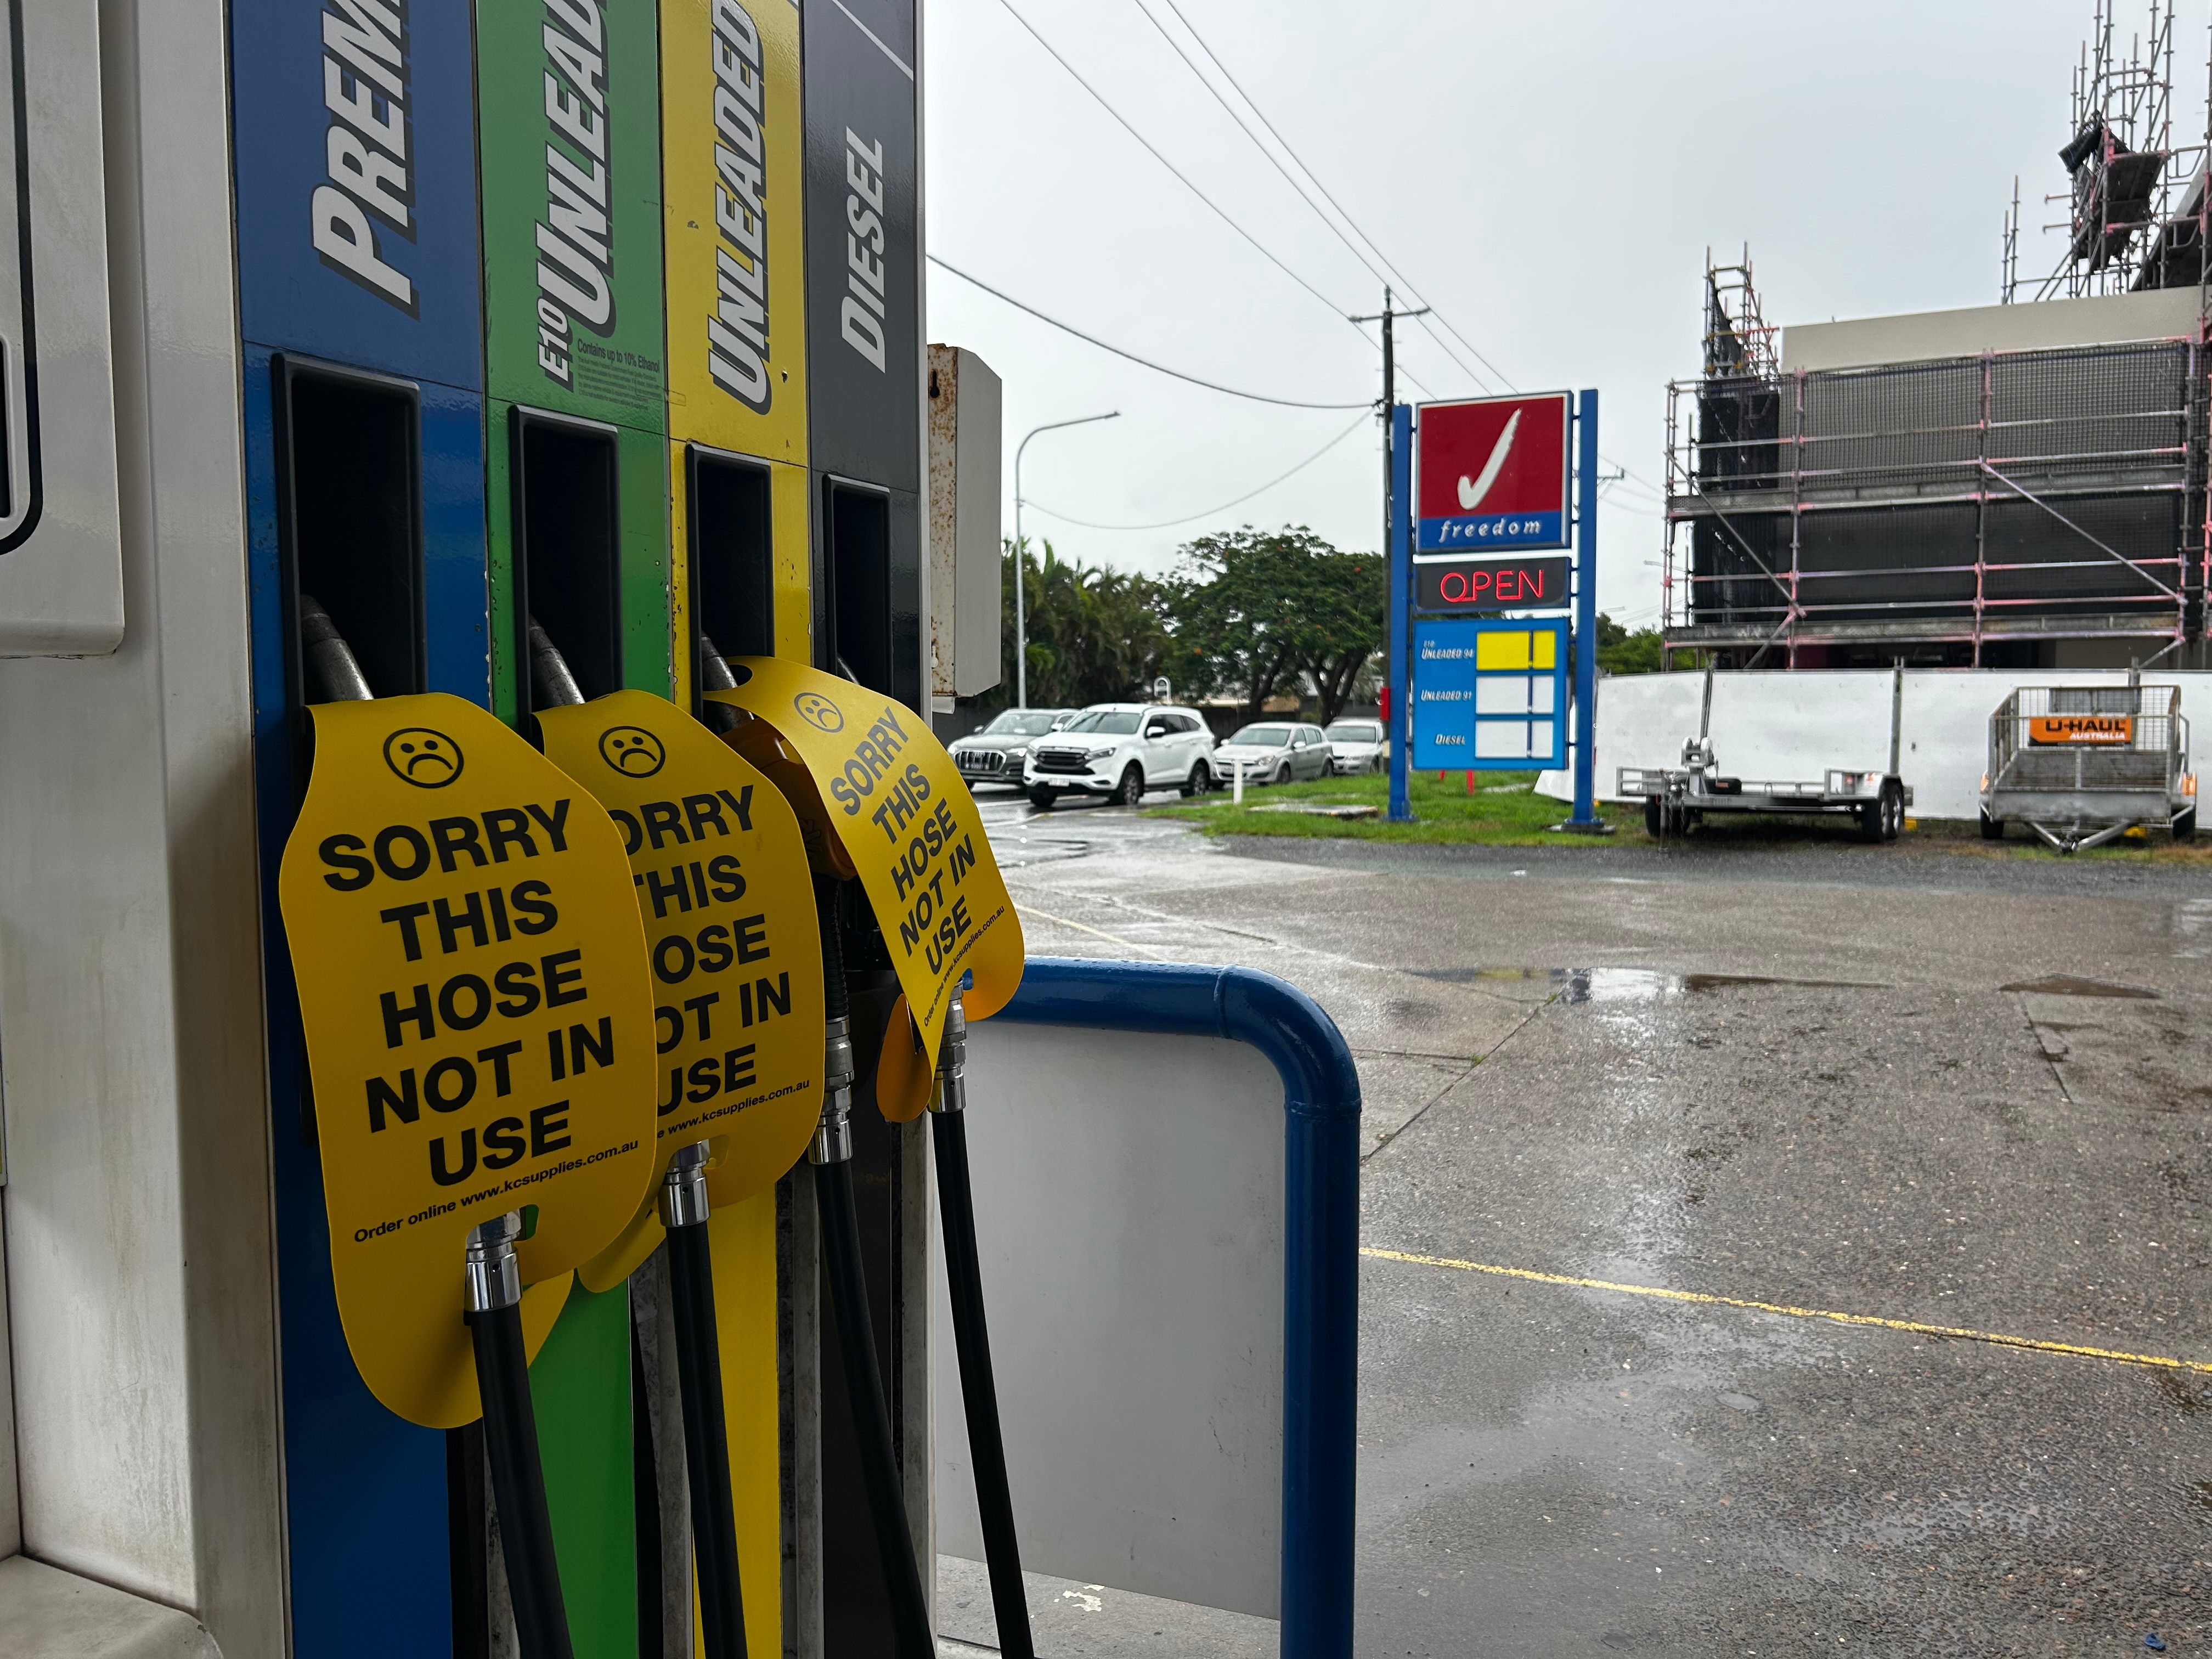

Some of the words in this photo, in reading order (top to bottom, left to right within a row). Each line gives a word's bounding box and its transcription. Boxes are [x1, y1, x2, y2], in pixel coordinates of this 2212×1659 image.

[312, 0, 411, 305] PREM
[709, 0, 768, 405] UNLEADED
[842, 127, 886, 374] DIESEL
[537, 298, 569, 382] E10
[578, 338, 606, 359] Contains
[607, 349, 616, 364] up
[616, 349, 623, 363] to
[624, 352, 637, 367] 10%
[638, 355, 660, 373] Ethanol
[1438, 517, 1542, 543] freedom
[1440, 569, 1543, 602] OPEN
[1463, 648, 1474, 659] 94
[1462, 690, 1472, 701] 91
[2045, 718, 2125, 732] U-HAUL
[2069, 732, 2125, 740] AUSTRALIA
[831, 706, 909, 816] SORRY
[319, 798, 571, 891] SORRY
[607, 785, 754, 856] ORRY
[872, 764, 930, 845] THIS
[633, 855, 747, 919] HIS
[890, 797, 957, 903] HOSE
[380, 880, 558, 962] THIS
[899, 867, 944, 958] NOT
[949, 833, 975, 887] IN
[925, 894, 972, 975] USE
[653, 913, 771, 984] OSE
[924, 1002, 935, 1028] Order
[934, 982, 944, 1006] online
[944, 905, 1005, 984] www.kcsupplies.com.au
[380, 949, 588, 1049] HOSE
[654, 991, 720, 1054] OT
[739, 971, 791, 1028] IN
[365, 1040, 522, 1133] NOT
[548, 1016, 614, 1082] IN
[668, 1080, 810, 1135] www.kcsupplies.com.au
[428, 1099, 572, 1187] USE
[354, 1219, 404, 1243] Order
[408, 1201, 456, 1225] online
[460, 1139, 639, 1206] www.kcsupplies.com.au
